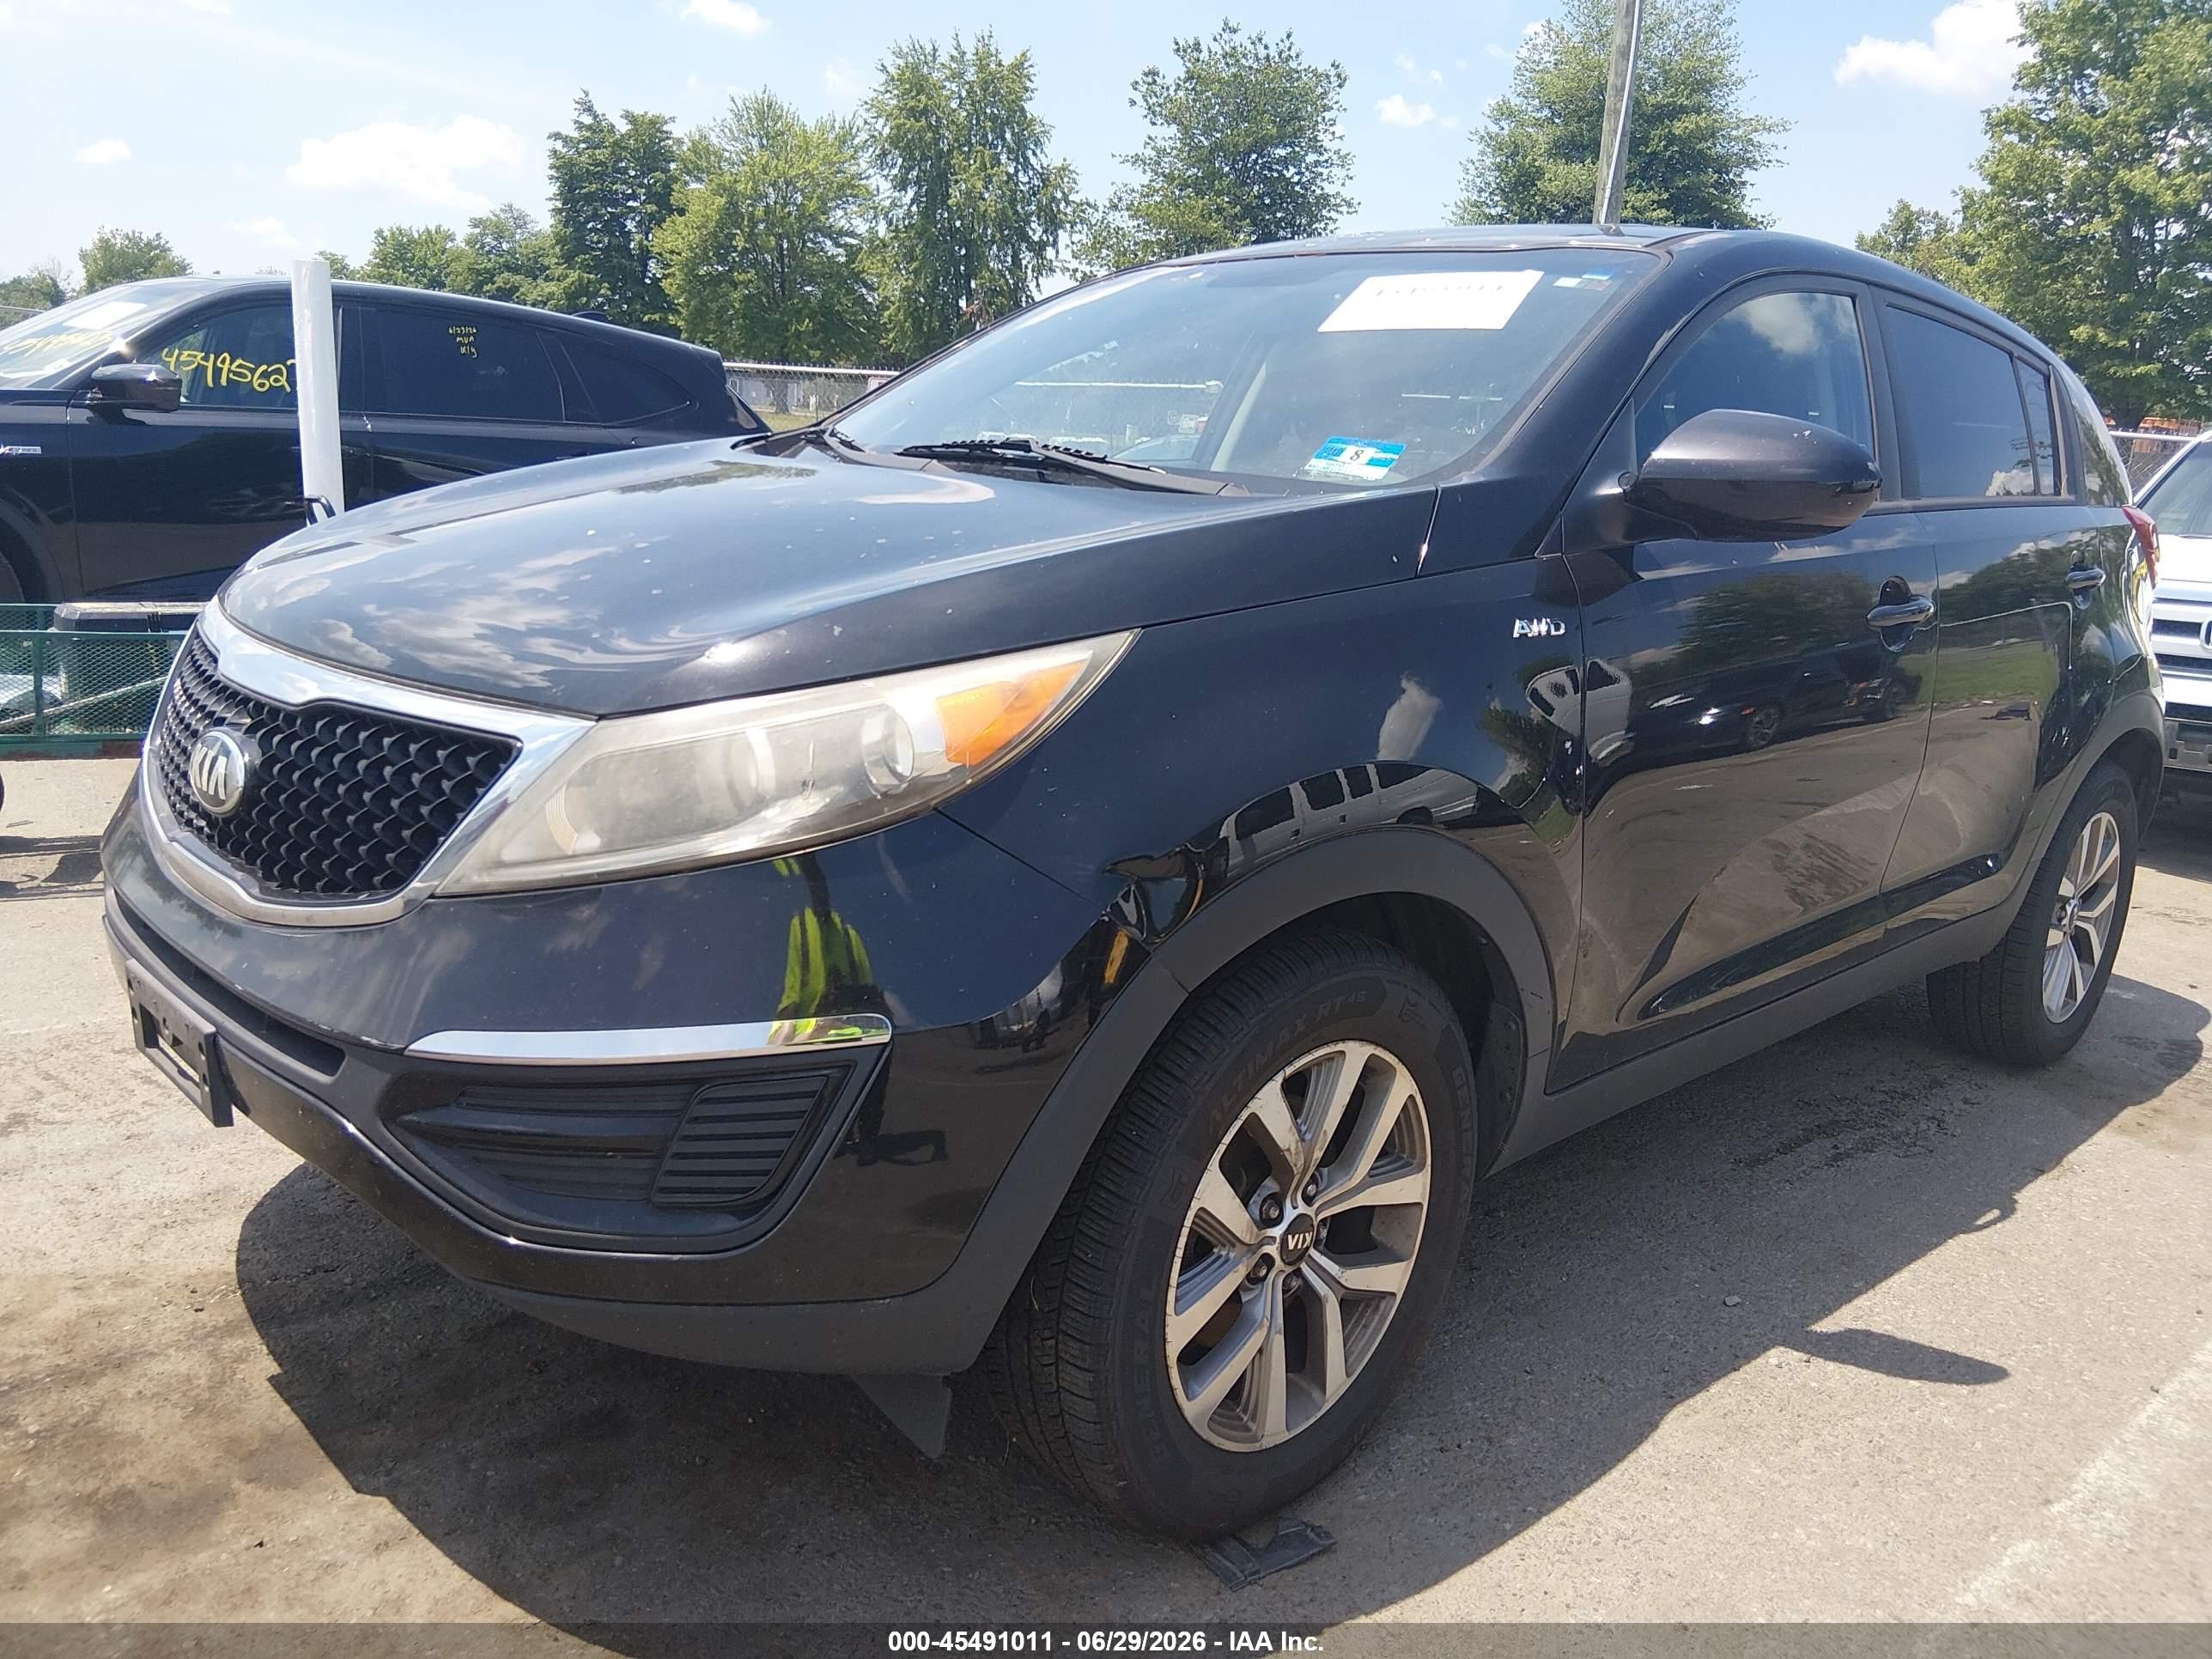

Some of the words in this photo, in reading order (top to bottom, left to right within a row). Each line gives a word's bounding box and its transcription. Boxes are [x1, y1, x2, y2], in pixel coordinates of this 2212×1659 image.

[161, 347, 296, 393] 4549562
[1349, 449, 1364, 462] 8
[1512, 618, 1566, 638] AWD
[191, 739, 228, 801] KIA
